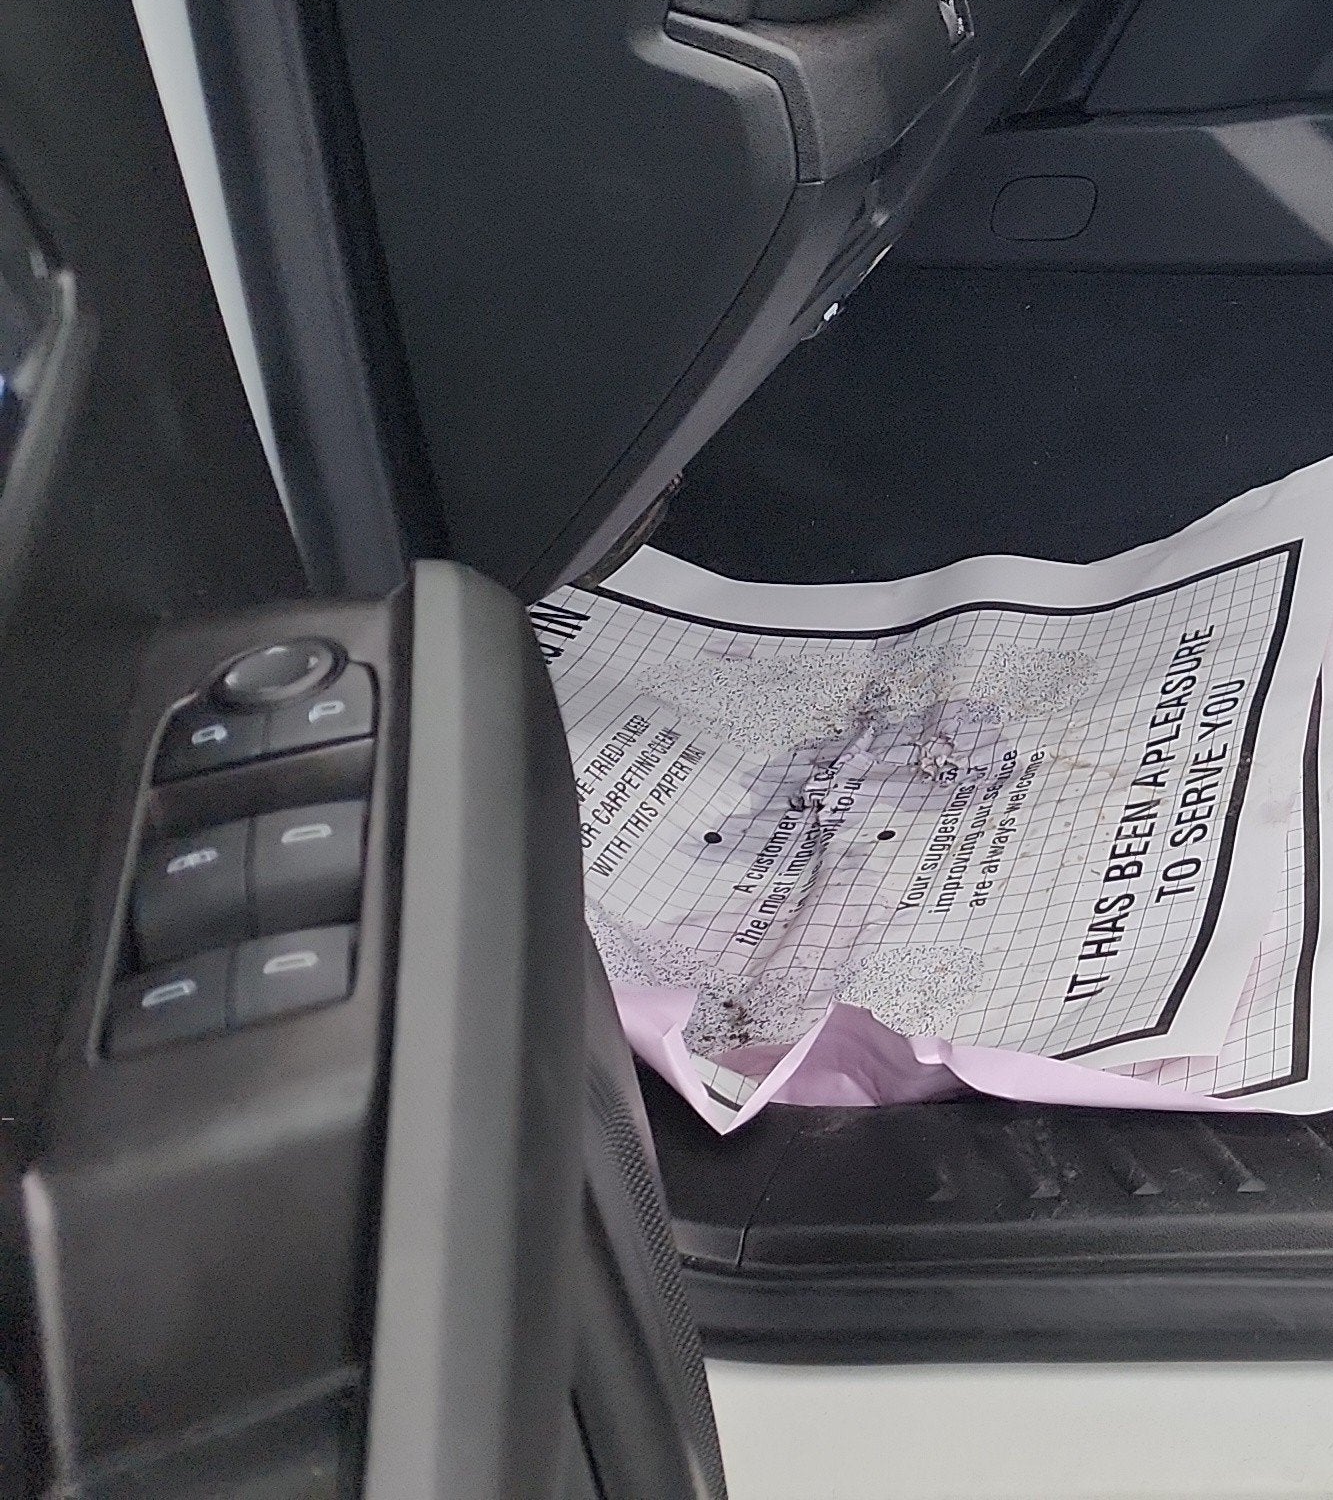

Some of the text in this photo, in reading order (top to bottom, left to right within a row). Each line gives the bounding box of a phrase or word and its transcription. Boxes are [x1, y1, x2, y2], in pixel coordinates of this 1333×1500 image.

[529, 601, 591, 639] IN
[583, 740, 626, 783] TRIED
[611, 727, 638, 750] TO
[621, 712, 652, 739] KEEP
[588, 741, 707, 881] WITH THIS PAPER MAT
[589, 747, 661, 826] CARPETING
[647, 723, 682, 757] CLEAN
[827, 789, 857, 821] to
[1063, 623, 1214, 1003] IT HAS BEEN A PLEASURE
[1154, 677, 1246, 901] TO SERVE YOU
[731, 808, 801, 900] A customer
[894, 868, 931, 920] Your
[916, 775, 980, 876] suggestions
[927, 820, 986, 922] improving
[968, 796, 994, 833] our
[974, 810, 1021, 880] always
[733, 914, 770, 950] the
[756, 873, 795, 920] most
[965, 873, 995, 914] are
